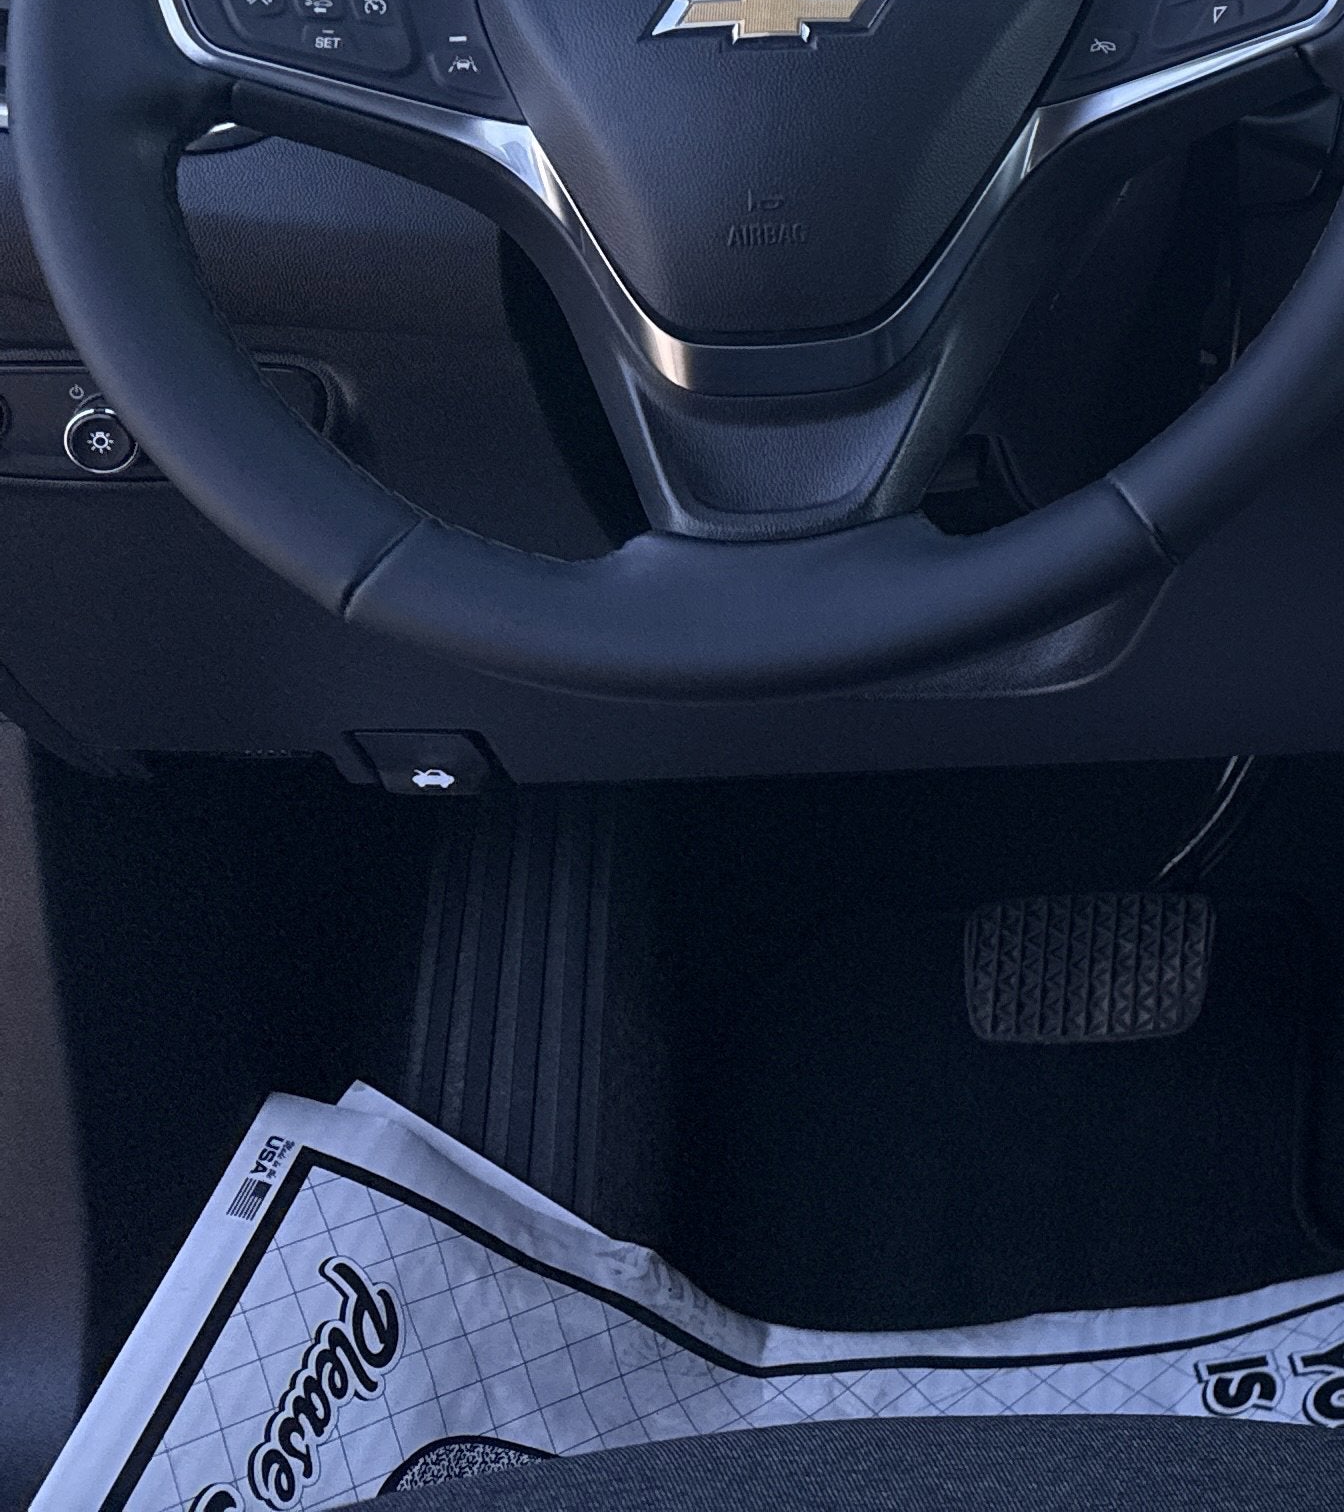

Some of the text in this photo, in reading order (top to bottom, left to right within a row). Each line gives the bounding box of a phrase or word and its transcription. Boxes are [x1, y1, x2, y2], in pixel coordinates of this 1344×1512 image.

[315, 36, 341, 49] SET
[249, 1135, 285, 1174] USA
[256, 1258, 402, 1506] Please
[1202, 1352, 1280, 1412] IS
